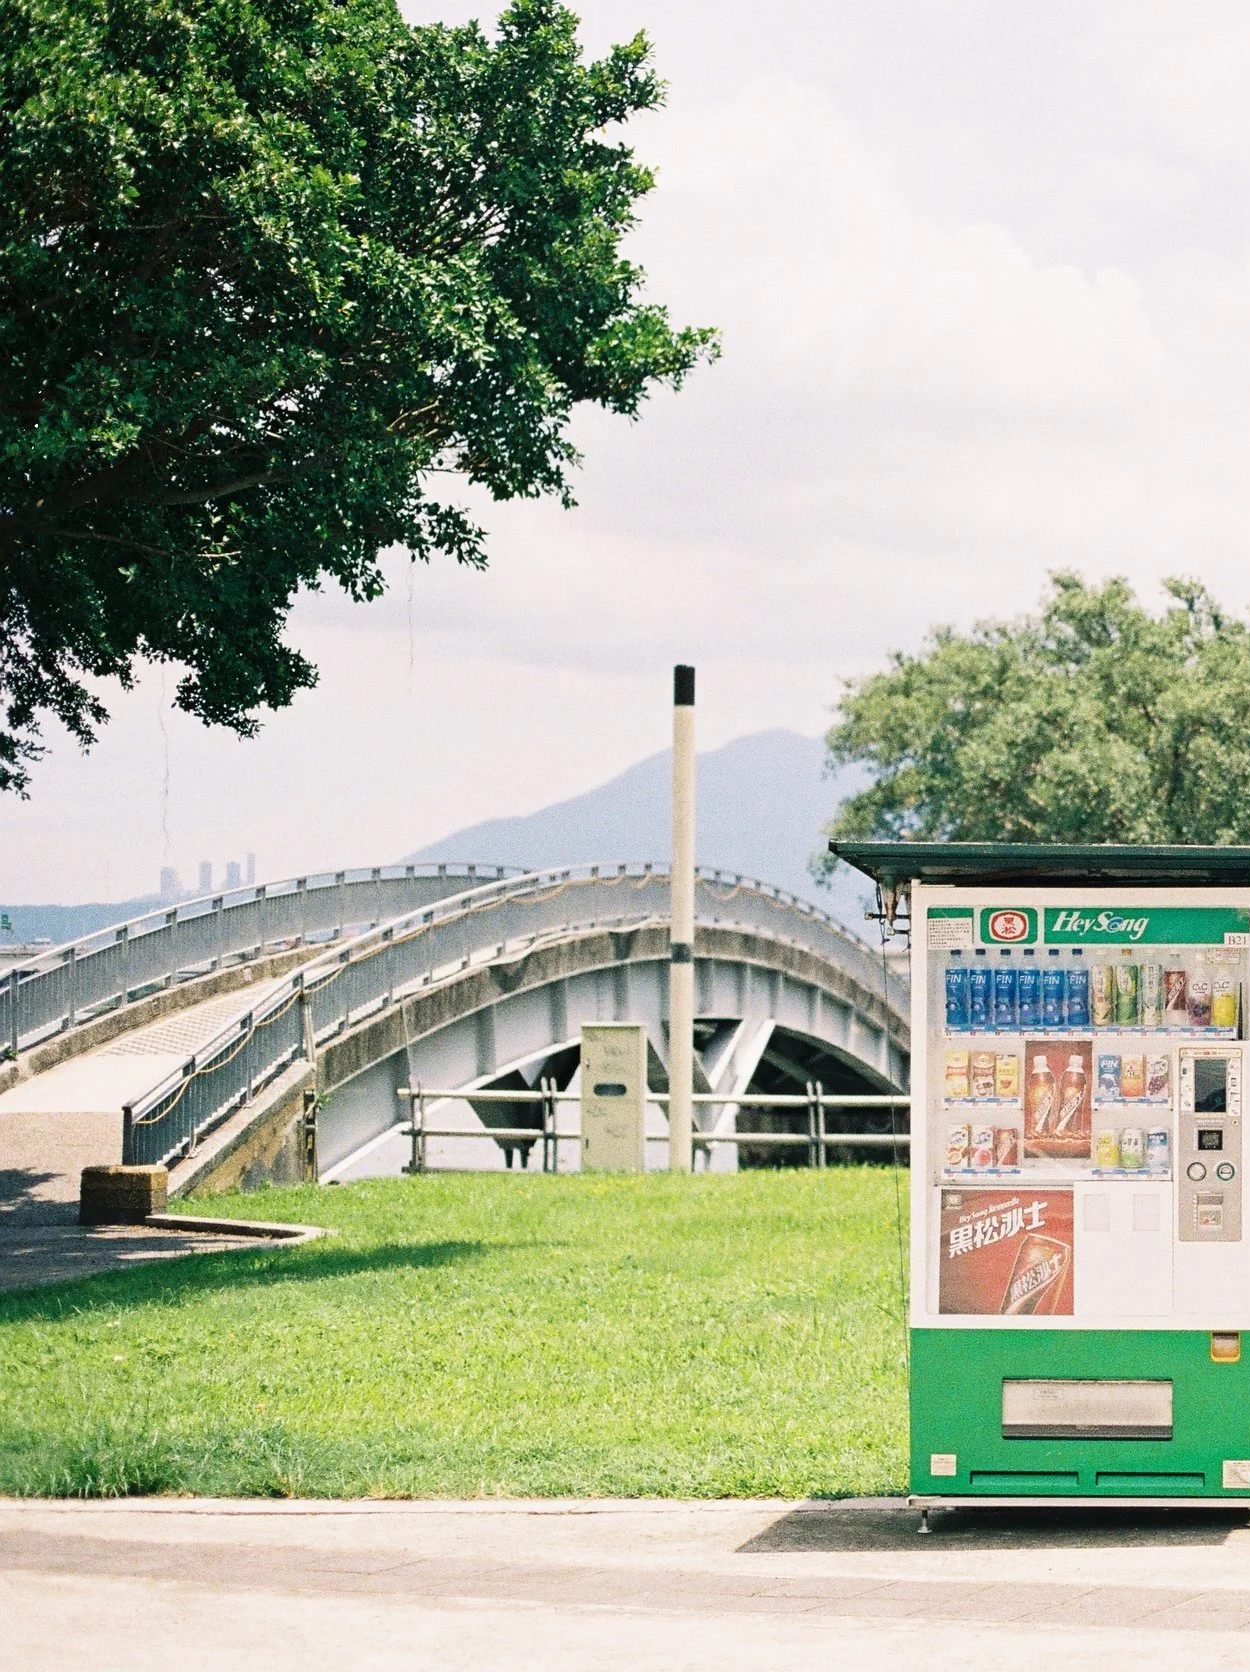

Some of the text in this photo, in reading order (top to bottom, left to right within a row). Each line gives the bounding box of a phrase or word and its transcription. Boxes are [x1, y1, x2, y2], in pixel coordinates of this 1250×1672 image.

[1228, 935, 1247, 945] B21
[970, 974, 986, 984] FIN
[996, 974, 1012, 984] FIN
[1019, 974, 1035, 984] FIN
[1043, 975, 1060, 985] FIN
[1069, 974, 1086, 985] FIN
[1100, 1060, 1119, 1068] FIN
[950, 1201, 1048, 1258] 黑松沙士
